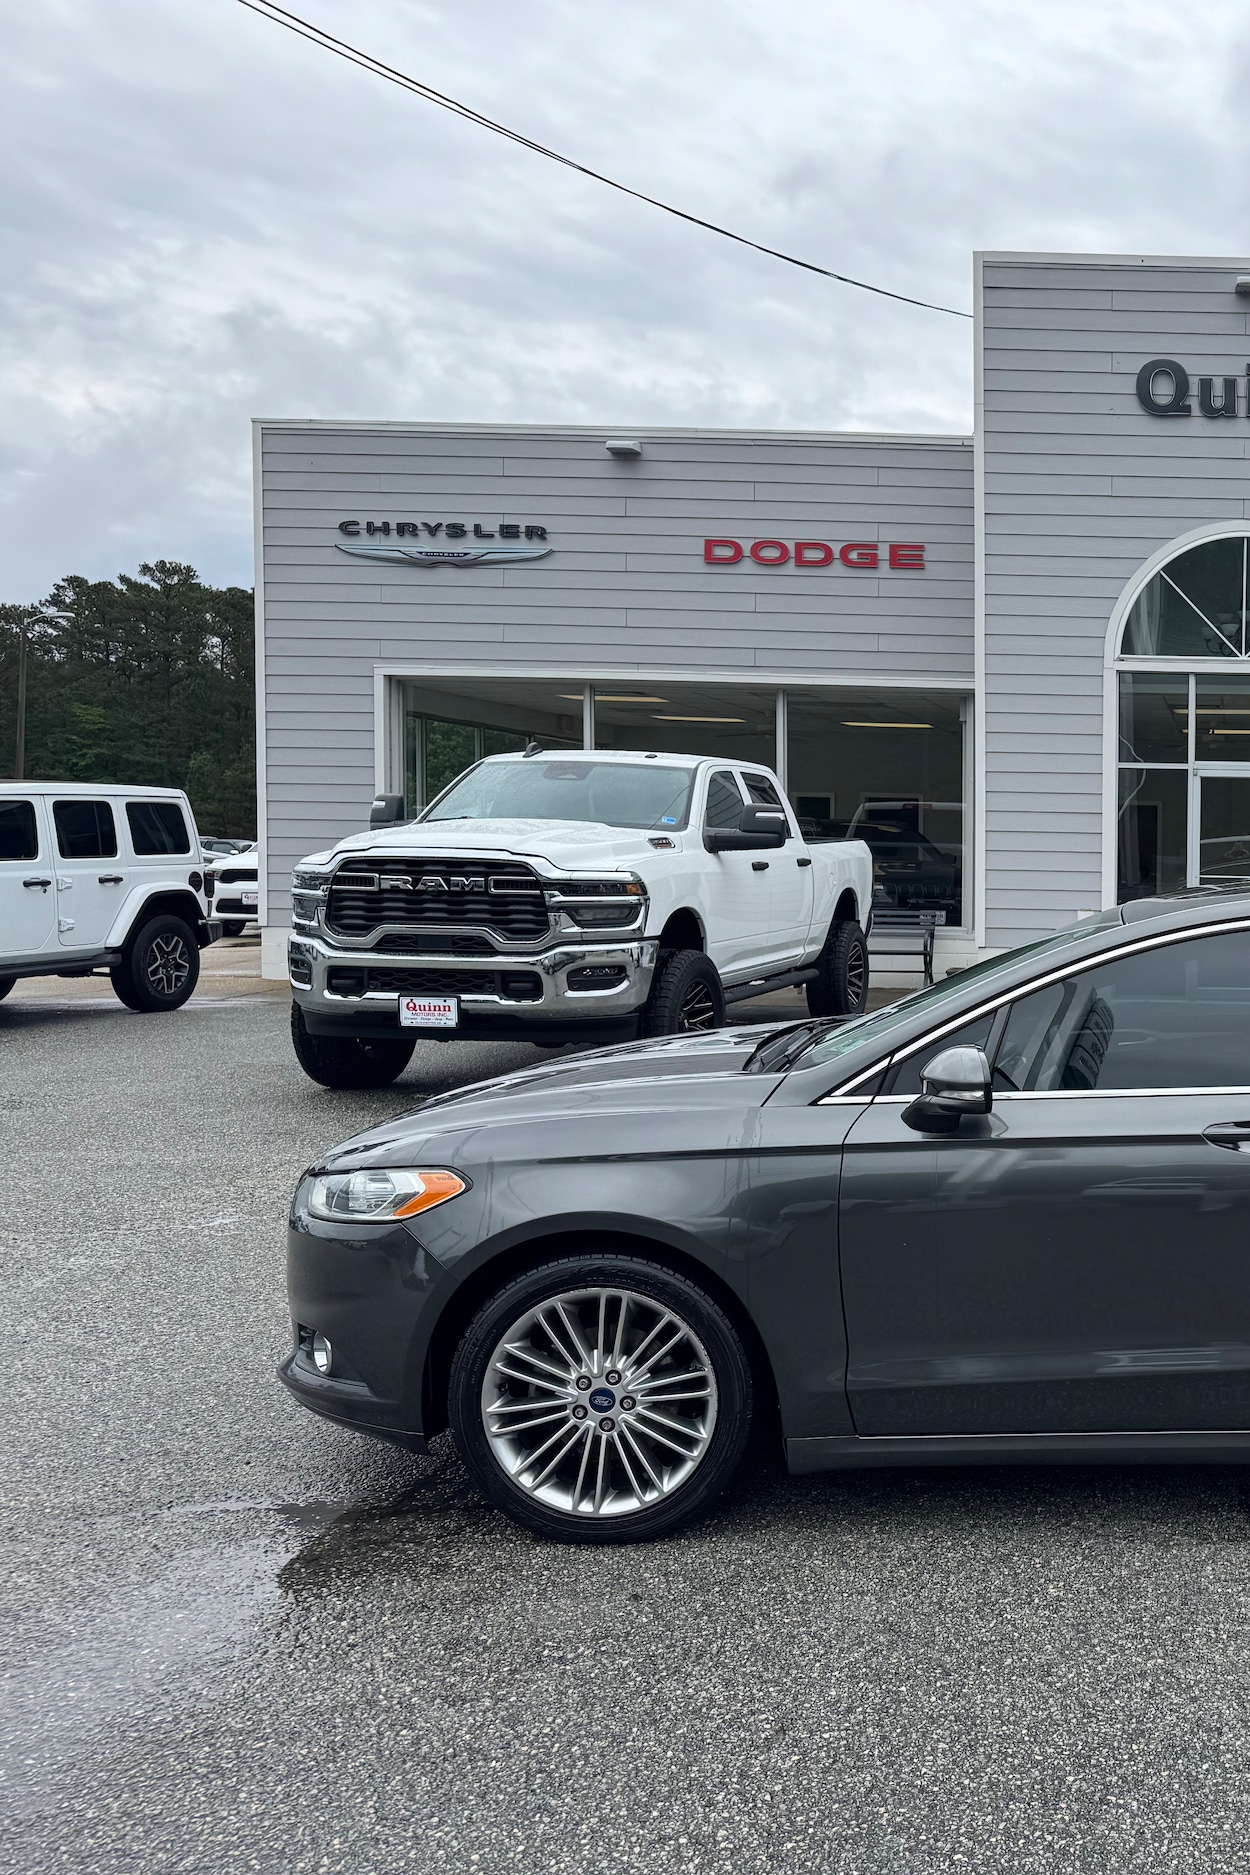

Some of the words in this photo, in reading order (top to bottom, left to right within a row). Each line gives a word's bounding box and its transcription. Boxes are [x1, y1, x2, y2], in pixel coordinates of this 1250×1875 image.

[337, 520, 548, 541] CHRYSLER
[703, 537, 926, 570] DODGE
[379, 875, 486, 892] RAM
[406, 1001, 452, 1012] Quinn
